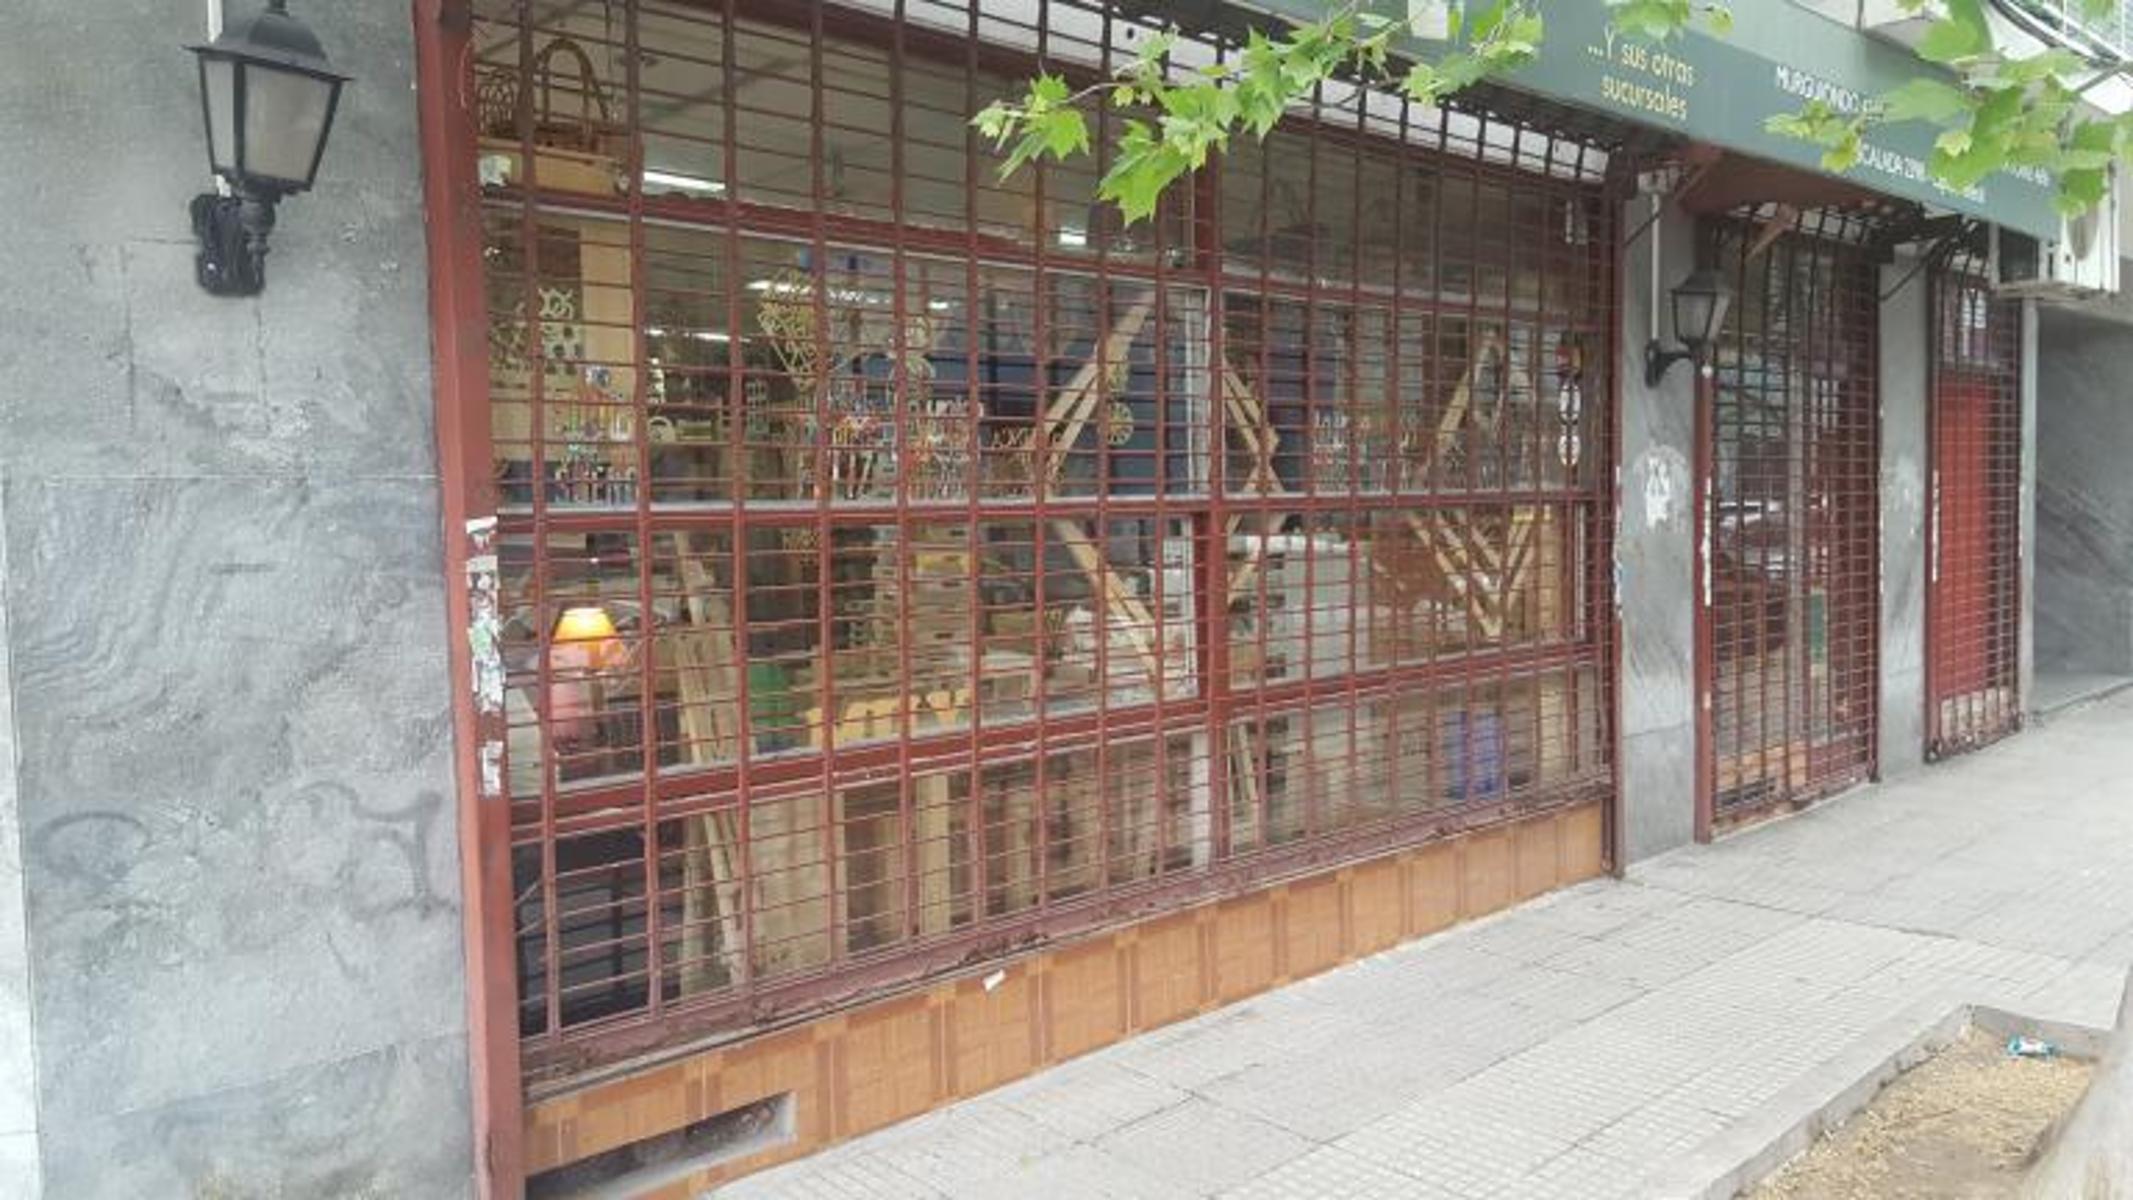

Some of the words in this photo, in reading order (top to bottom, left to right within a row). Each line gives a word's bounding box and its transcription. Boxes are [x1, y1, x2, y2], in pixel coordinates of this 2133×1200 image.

[1621, 43, 1646, 71] sus
[1651, 53, 1693, 87] otras
[1601, 75, 1687, 120] sucursales
